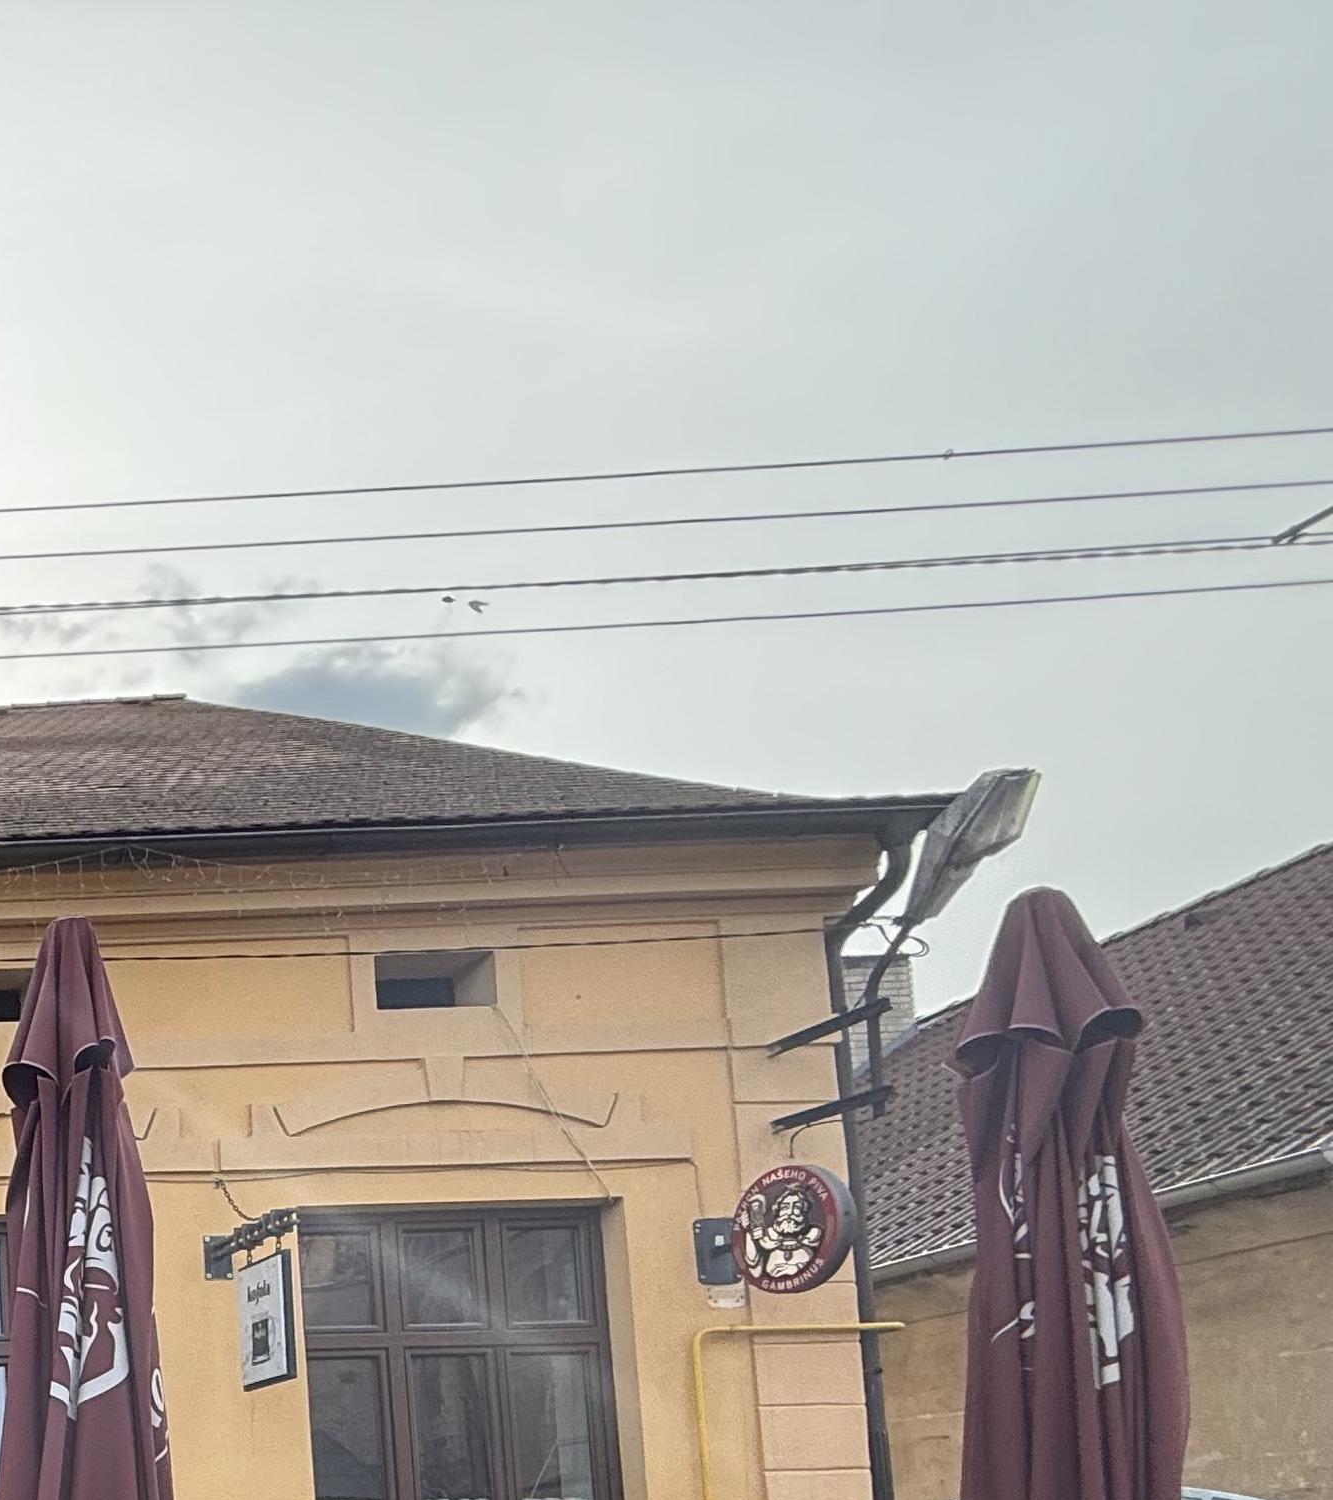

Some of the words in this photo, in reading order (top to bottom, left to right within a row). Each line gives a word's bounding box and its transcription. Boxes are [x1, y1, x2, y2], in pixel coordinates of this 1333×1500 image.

[762, 1169, 807, 1187] NAŠEHO
[808, 1178, 828, 1201] PIVA
[761, 1257, 825, 1291] GAMBRINUS
